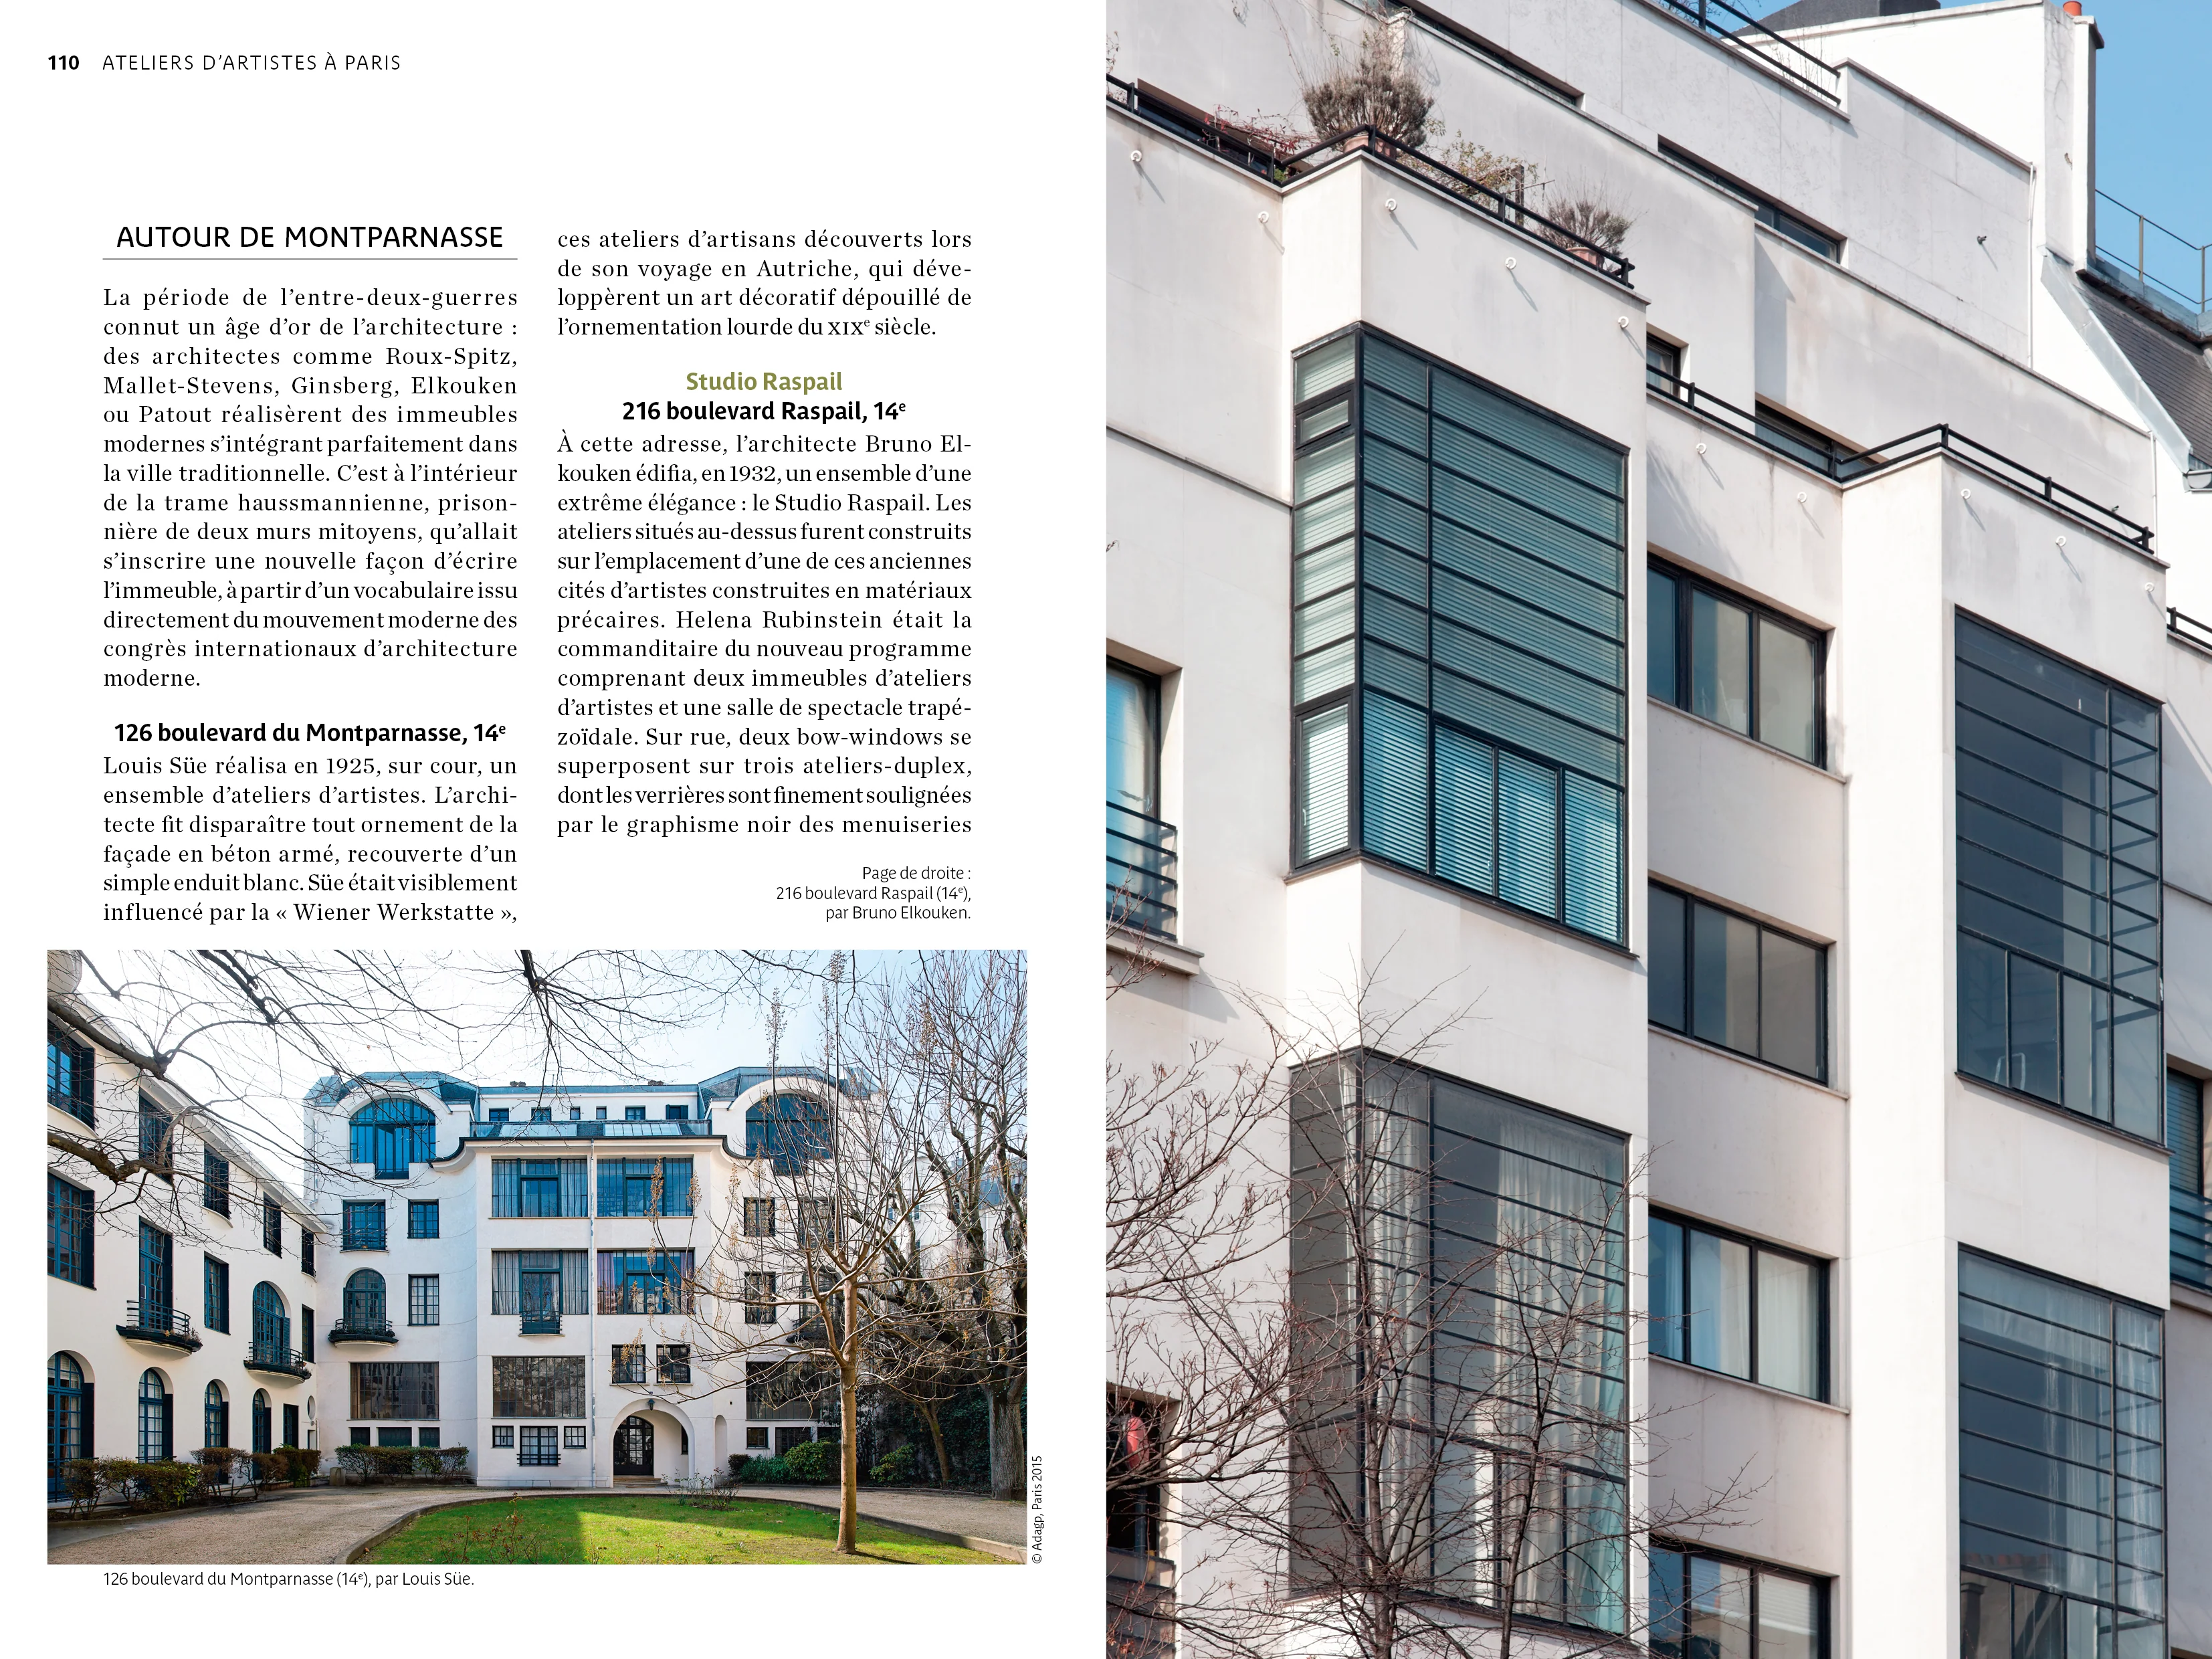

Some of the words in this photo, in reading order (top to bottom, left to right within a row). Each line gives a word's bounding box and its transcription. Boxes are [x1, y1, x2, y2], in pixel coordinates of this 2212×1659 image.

[47, 55, 80, 70] 110
[102, 55, 193, 70] ATELIERS
[203, 54, 316, 70] D’ARTISTES
[324, 52, 336, 70] À
[346, 55, 400, 70] PARIS
[116, 226, 231, 248] AUTOUR
[241, 226, 274, 248] DE
[286, 226, 503, 248] MONTPARNASSE
[558, 235, 590, 248] ces
[599, 229, 679, 248] ateliers
[688, 229, 795, 248] d’artisans
[805, 229, 922, 248] découverts
[931, 229, 971, 248] lors
[558, 259, 581, 277] de
[592, 264, 629, 277] son
[637, 263, 712, 282] voyage
[722, 264, 747, 277] en
[756, 259, 858, 280] Autriche,
[869, 260, 904, 282] qui
[913, 258, 971, 277] déve-
[103, 288, 130, 306] La
[143, 287, 229, 310] période
[243, 288, 267, 306] de
[280, 288, 517, 310] l’entre-deux-guerres
[557, 317, 722, 335] l’ornementation
[726, 317, 793, 335] lourde
[798, 317, 824, 335] du
[875, 316, 936, 335] siècle.
[103, 376, 279, 397] Mallet-Stevens,
[292, 376, 399, 399] Ginsberg,
[411, 376, 517, 394] Elkouken
[686, 371, 757, 391] Studio
[763, 371, 843, 395] Raspail
[104, 410, 129, 423] ou
[138, 405, 211, 423] Patout
[221, 404, 342, 423] réalisèrent
[352, 405, 387, 423] des
[397, 405, 517, 423] immeubles
[623, 401, 661, 420] 216
[667, 401, 775, 420] boulevard
[782, 401, 868, 425] Raspail,
[557, 428, 574, 452] À
[581, 436, 633, 452] cette
[642, 434, 727, 456] adresse,
[736, 434, 856, 452] l’architecte
[865, 435, 932, 452] Bruno
[940, 434, 971, 452] El-
[104, 493, 127, 511] de
[136, 493, 155, 511] la
[164, 495, 228, 511] trame
[237, 493, 429, 514] haussmannienne,
[438, 494, 517, 516] prison-
[104, 521, 157, 540] nière
[166, 522, 189, 540] de
[197, 522, 249, 540] deux
[256, 527, 310, 540] murs
[318, 522, 423, 545] mitoyens,
[430, 522, 518, 545] qu’allait
[104, 552, 205, 569] s’inscrire
[215, 557, 255, 569] une
[264, 551, 356, 569] nouvelle
[365, 551, 425, 575] façon
[434, 551, 517, 569] d’écrire
[103, 581, 222, 602] l’immeuble,
[227, 580, 237, 599] à
[240, 581, 302, 603] partir
[305, 581, 350, 599] d’un
[353, 581, 474, 599] vocabulaire
[477, 581, 518, 599] issu
[557, 609, 665, 633] précaires.
[676, 610, 752, 628] Helena
[762, 610, 883, 628] Rubinstein
[893, 609, 943, 628] était
[952, 610, 972, 628] la
[104, 638, 186, 662] congrès
[194, 640, 357, 657] internationaux
[364, 639, 517, 657] d’architecture
[558, 670, 686, 691] comprenant
[694, 668, 745, 686] deux
[751, 668, 867, 686] immeubles
[876, 668, 971, 686] d’ateliers
[114, 723, 153, 742] 126
[159, 722, 267, 742] boulevard
[272, 722, 300, 742] du
[306, 723, 468, 747] Montparnasse,
[557, 727, 638, 745] zoïdale.
[646, 728, 683, 745] Sur
[690, 733, 731, 749] rue,
[739, 727, 791, 745] deux
[796, 727, 942, 745] bow-windows
[950, 733, 971, 745] se
[103, 757, 162, 774] Louis
[170, 757, 207, 774] Süe
[215, 755, 287, 774] réalisa
[294, 761, 319, 774] en
[326, 758, 381, 777] 1925,
[389, 761, 423, 774] sur
[430, 761, 482, 777] cour,
[490, 761, 517, 774] un
[558, 785, 603, 803] dont
[605, 785, 632, 803] les
[635, 785, 724, 803] verrières
[728, 787, 771, 803] sont
[773, 785, 864, 803] finement
[866, 785, 971, 808] soulignées
[103, 817, 155, 833] tecte
[161, 815, 183, 833] fit
[189, 814, 306, 838] disparaître
[312, 817, 355, 833] tout
[361, 817, 464, 833] ornement
[470, 815, 493, 833] de
[499, 815, 518, 833] la
[557, 820, 593, 838] par
[601, 815, 618, 833] le
[627, 815, 738, 838] graphisme
[746, 815, 791, 833] noir
[799, 815, 833, 833] des
[842, 815, 971, 833] menuiseries
[104, 873, 170, 896] simple
[174, 873, 240, 891] enduit
[242, 873, 304, 891] blanc.
[308, 874, 344, 891] Süe
[348, 872, 395, 891] était
[397, 873, 518, 891] visiblement
[863, 866, 897, 883] Page
[900, 866, 918, 880] de
[921, 866, 964, 880] droite
[777, 886, 802, 900] 216
[805, 886, 878, 900] boulevard
[882, 886, 933, 903] Raspail
[826, 908, 849, 922] par
[853, 906, 897, 919] Bruno
[901, 905, 971, 919] Elkouken.
[1031, 1456, 1042, 1482] 2015
[1031, 1484, 1042, 1510] Paris
[1031, 1514, 1045, 1551] Adagp,
[103, 1572, 128, 1585] 126
[132, 1571, 204, 1585] boulevard
[207, 1571, 226, 1585] du
[231, 1572, 333, 1589] Montparnasse
[376, 1575, 399, 1589] par
[403, 1571, 441, 1585] Louis
[444, 1571, 474, 1585] Süe.
